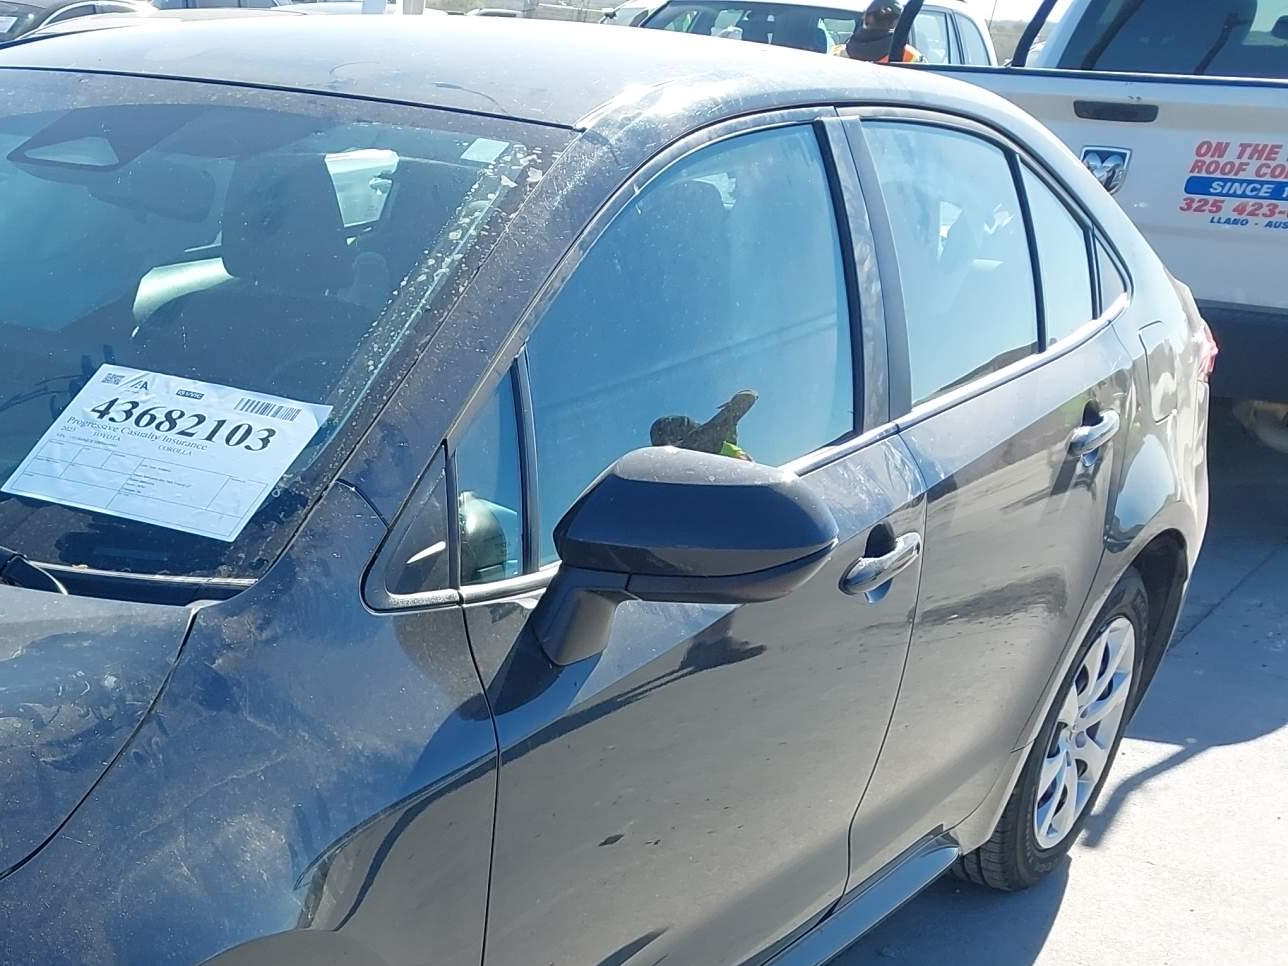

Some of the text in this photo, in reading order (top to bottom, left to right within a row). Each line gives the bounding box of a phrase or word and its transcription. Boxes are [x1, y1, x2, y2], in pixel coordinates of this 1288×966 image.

[1195, 140, 1231, 159] ON
[1236, 142, 1284, 162] THE
[1189, 159, 1250, 177] ROOF
[1209, 181, 1274, 197] SINCE
[1179, 196, 1225, 214] 325
[66, 416, 120, 434] Progressive
[120, 427, 162, 442] Casualty
[162, 434, 208, 451] Insurance
[90, 397, 276, 452] 43682103
